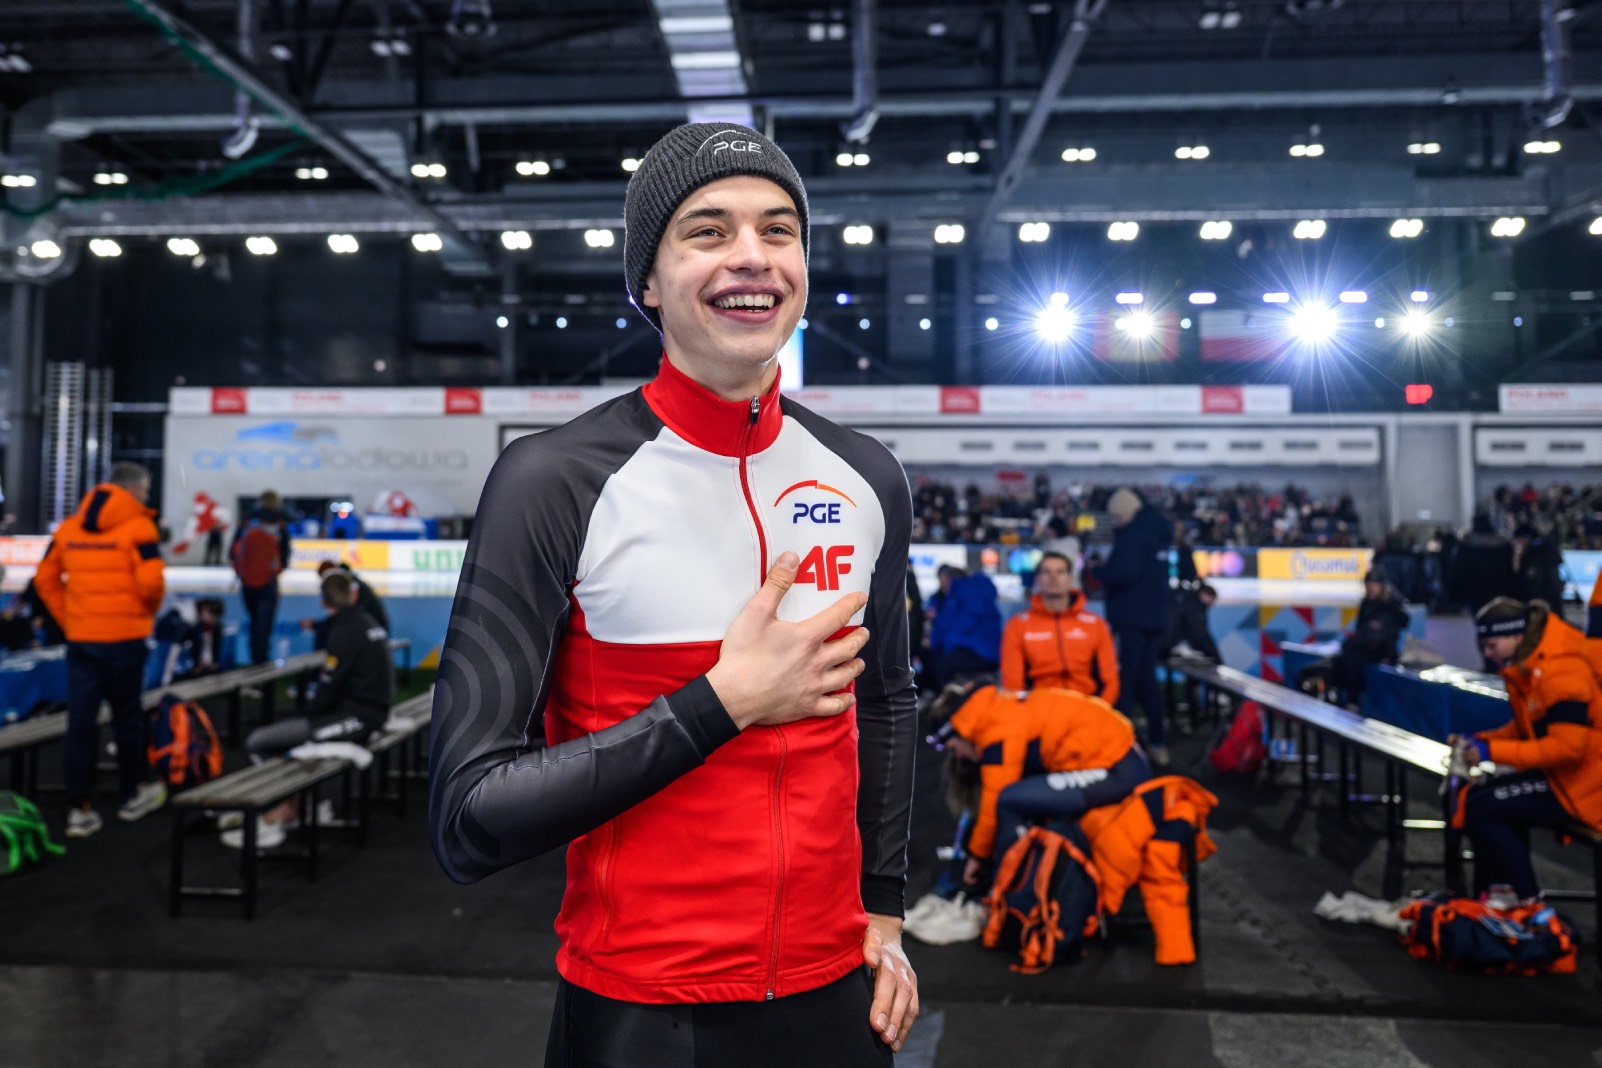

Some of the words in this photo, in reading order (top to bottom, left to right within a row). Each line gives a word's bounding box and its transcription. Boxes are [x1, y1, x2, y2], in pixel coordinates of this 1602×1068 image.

[714, 140, 761, 155] PGE
[793, 503, 841, 524] PGE
[794, 545, 855, 591] 4F
